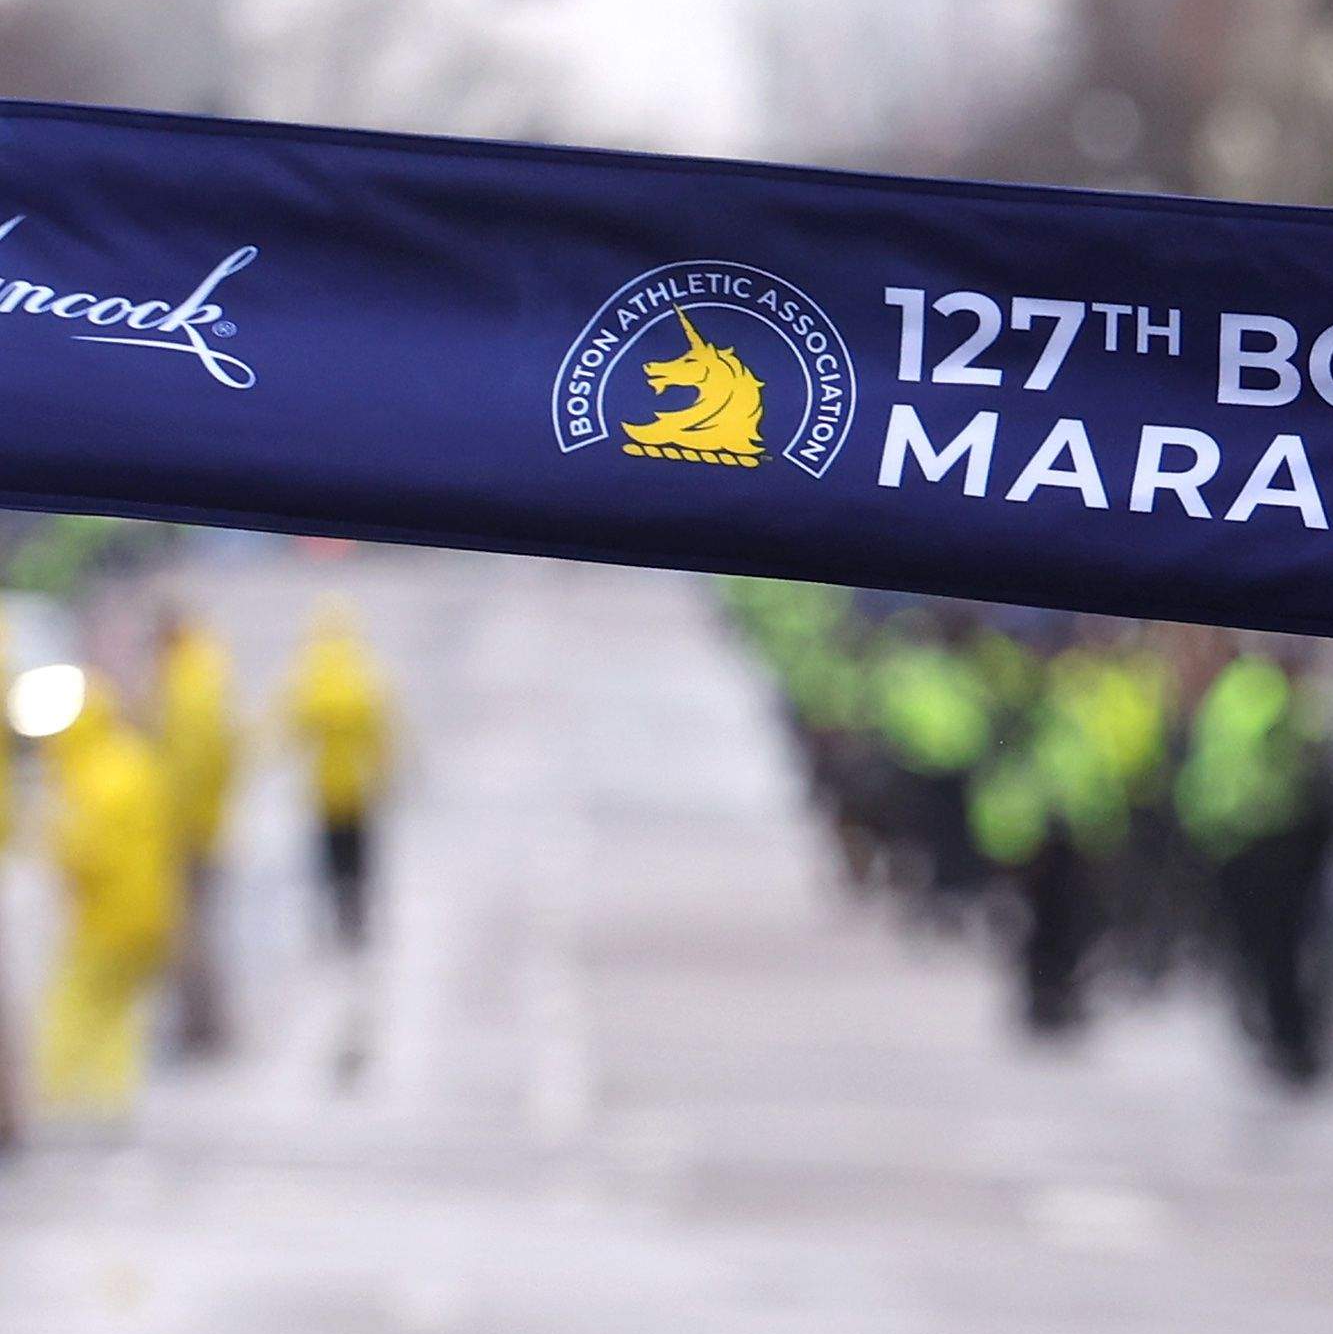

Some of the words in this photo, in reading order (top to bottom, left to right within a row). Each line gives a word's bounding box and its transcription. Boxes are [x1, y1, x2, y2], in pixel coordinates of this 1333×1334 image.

[566, 328, 620, 437] BOSTON
[616, 272, 752, 332] ATHLETIC
[757, 289, 843, 463] ASSOCIATION
[884, 286, 1181, 392] 127TH
